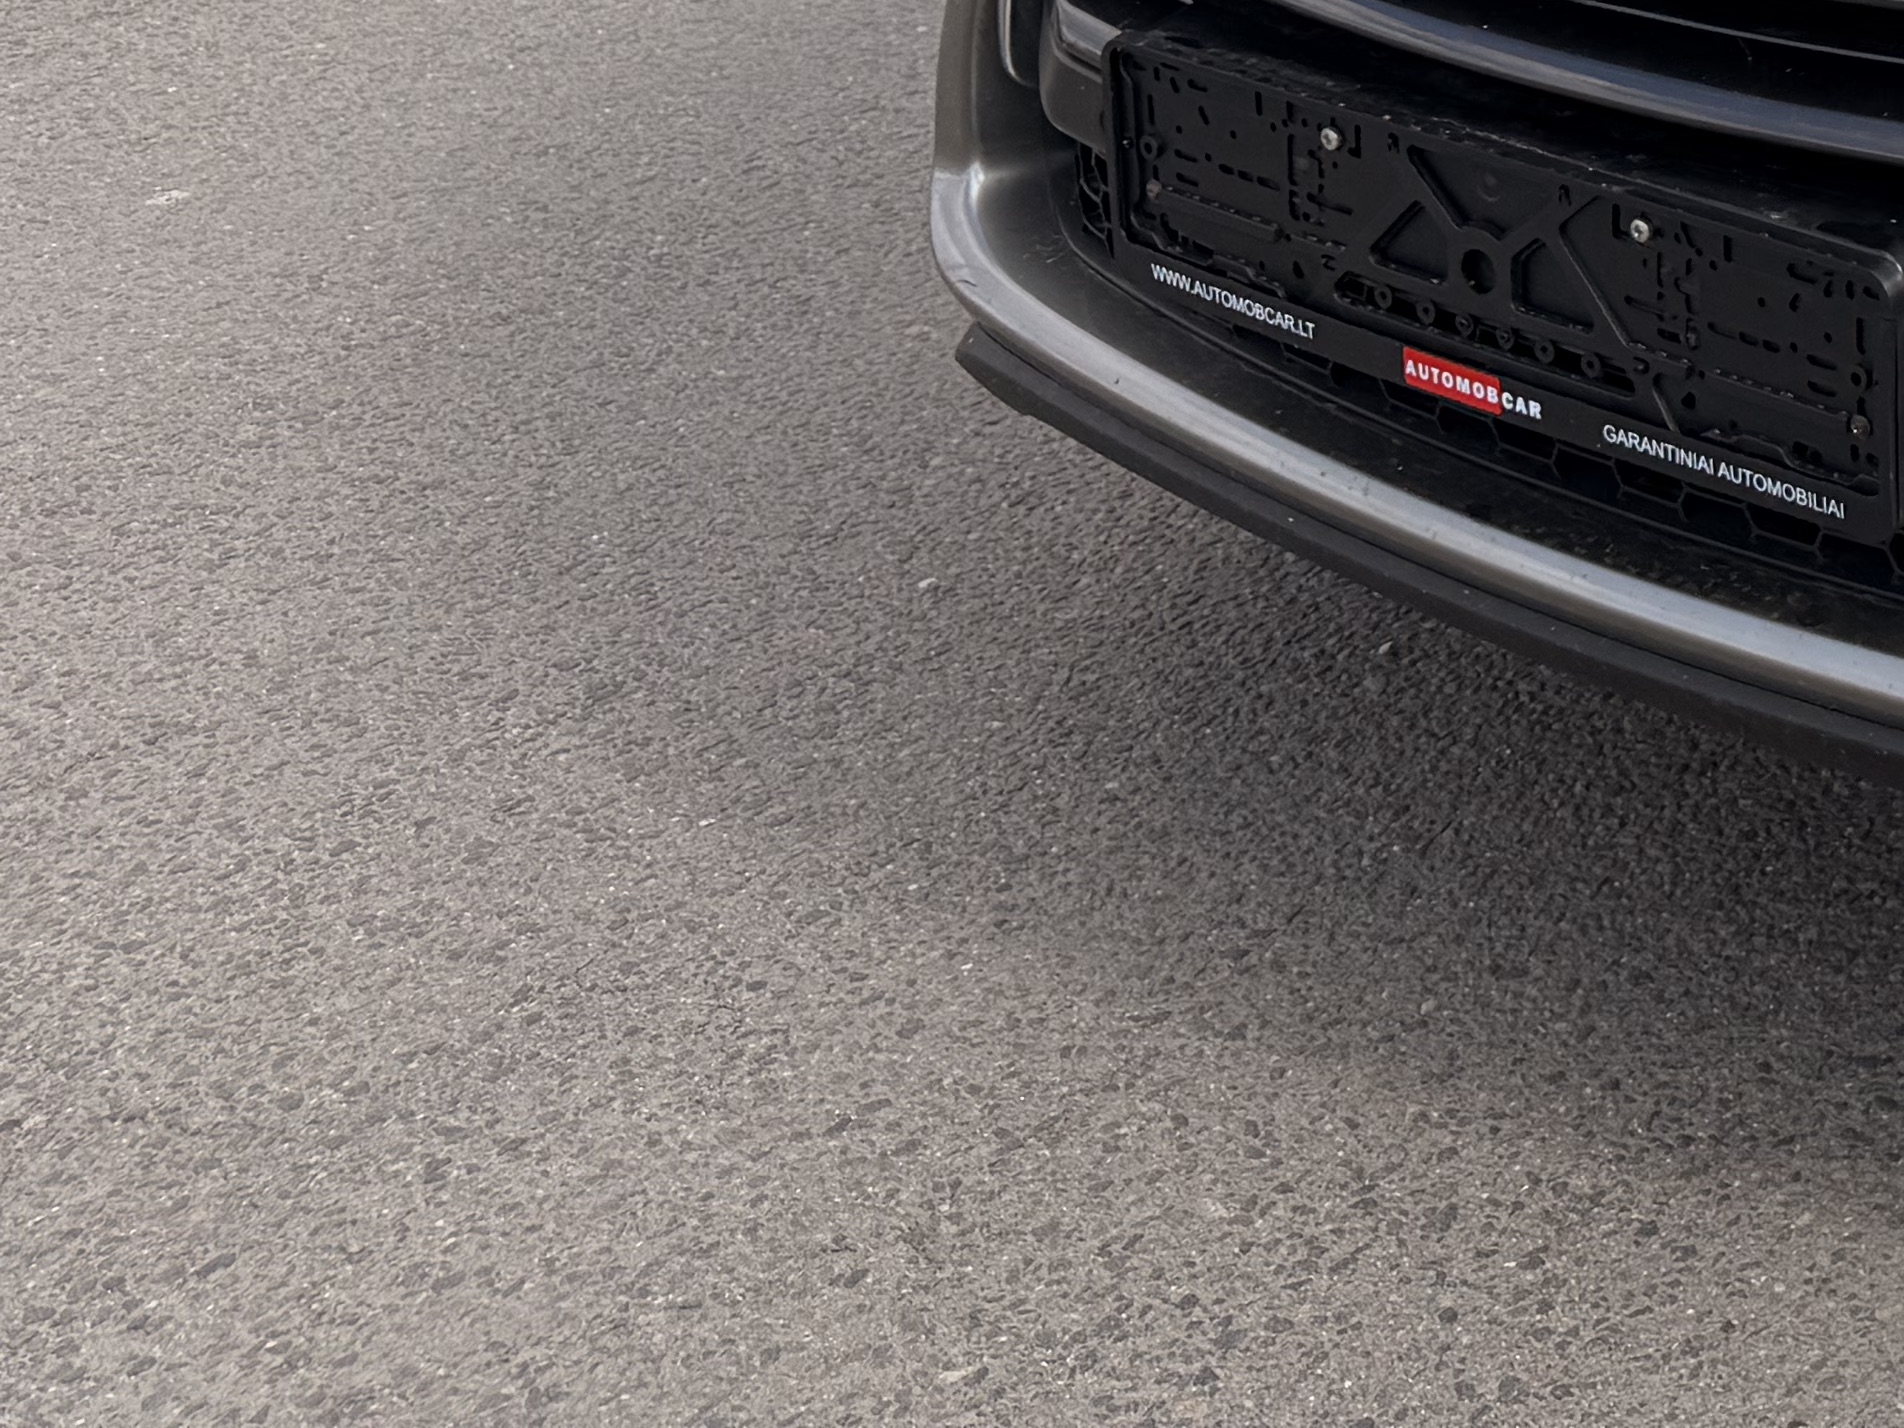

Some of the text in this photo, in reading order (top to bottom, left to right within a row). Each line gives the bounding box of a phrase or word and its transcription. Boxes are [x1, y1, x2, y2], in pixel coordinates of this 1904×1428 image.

[1151, 263, 1315, 339] WWW.AUTOMOBCAR.LT
[1405, 359, 1542, 419] AUTOMOBCAR
[1602, 424, 1845, 519] GARANTINIAI AUTOMOBILIAI
